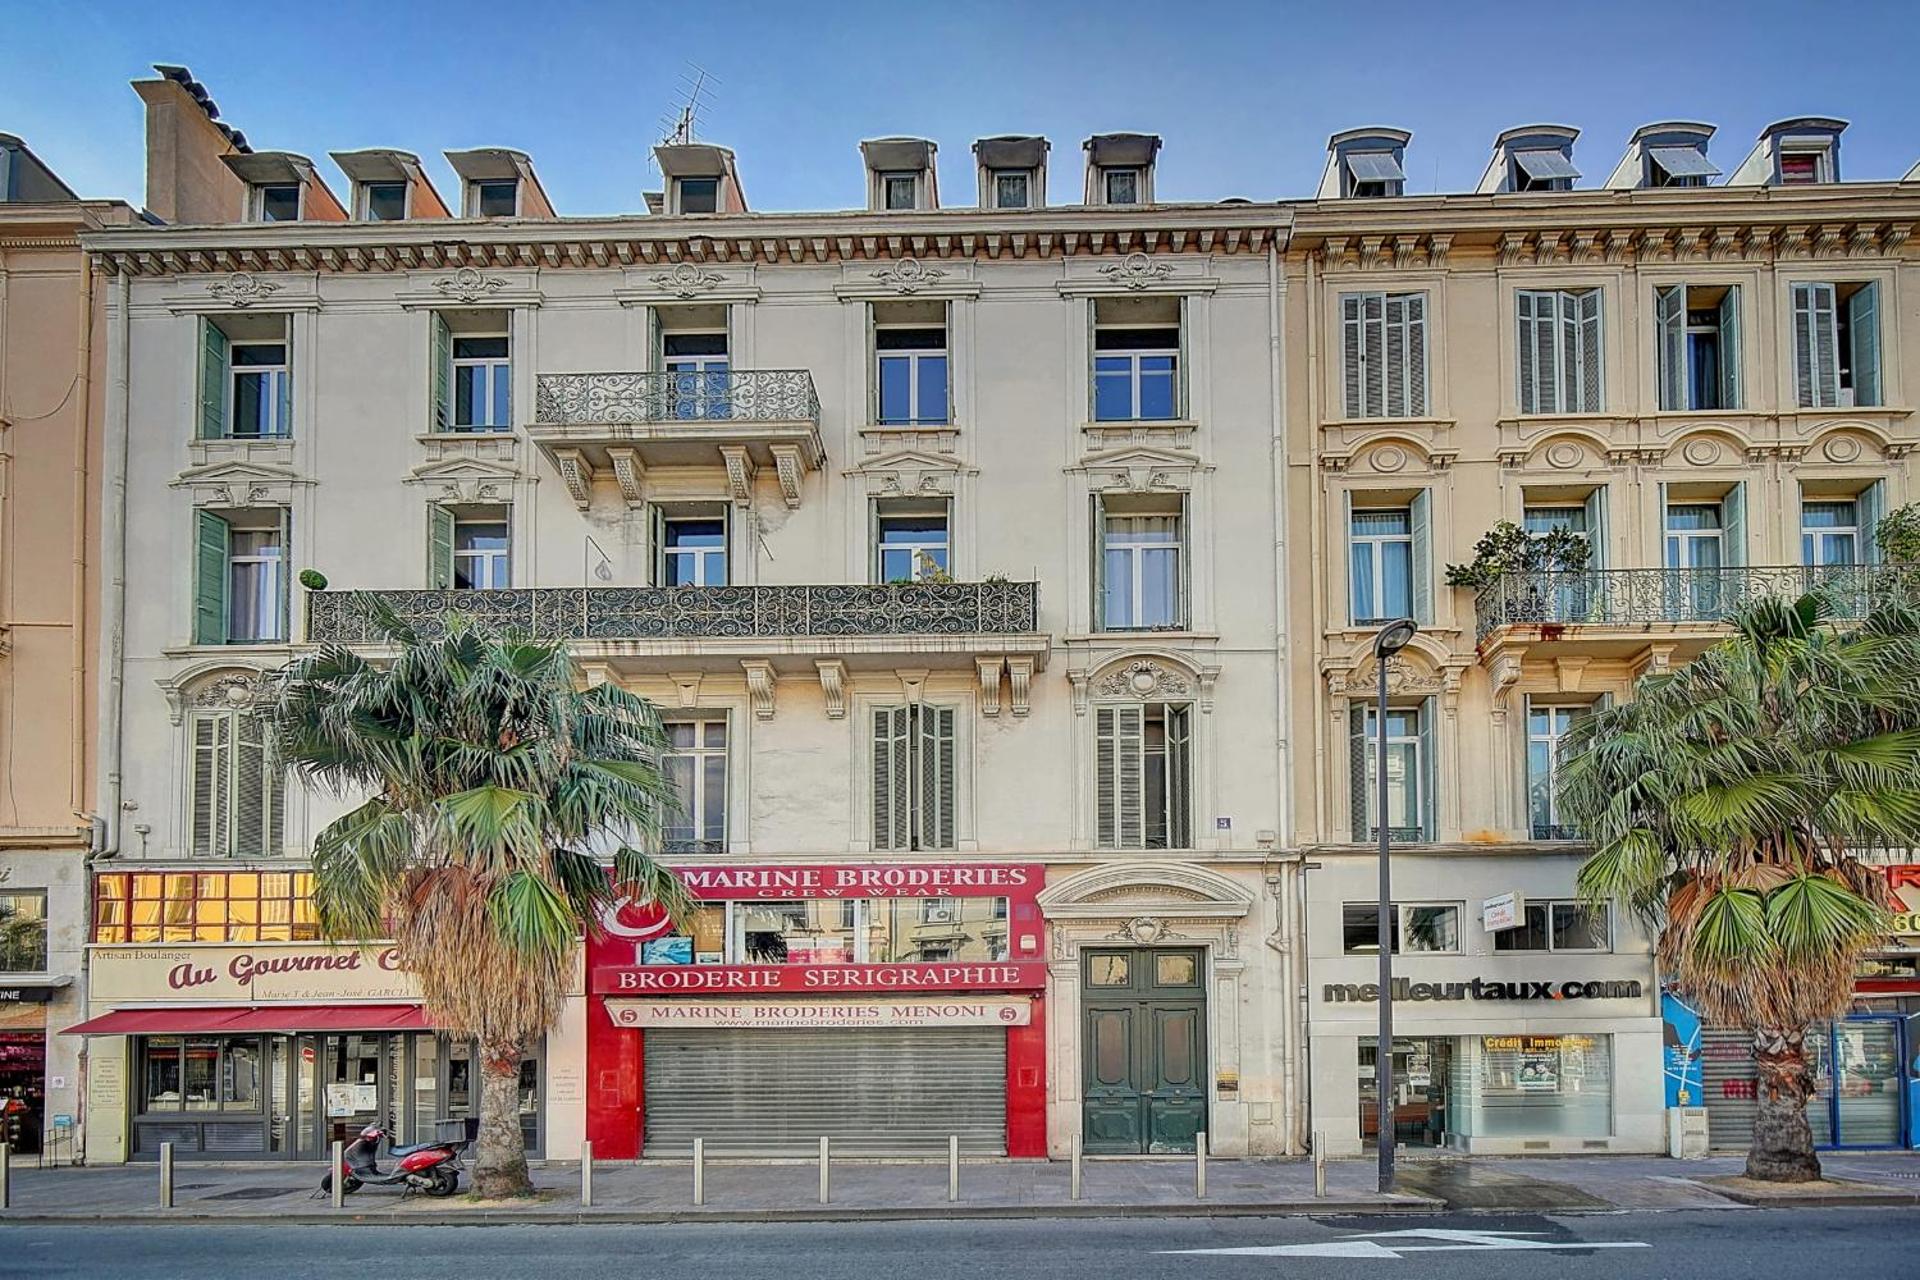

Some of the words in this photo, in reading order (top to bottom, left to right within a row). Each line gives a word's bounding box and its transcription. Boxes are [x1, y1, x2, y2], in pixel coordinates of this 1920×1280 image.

[682, 870, 821, 888] MARINE
[836, 868, 1027, 886] BRODERIES
[757, 889, 844, 898] CREW
[866, 888, 952, 896] WEAR
[93, 950, 132, 960] Artisan
[134, 950, 192, 962] Boulanger
[168, 962, 218, 989] Au
[228, 950, 361, 985] Gourmet
[618, 970, 782, 989] BRODERIE
[804, 967, 1020, 987] SERIGRAPHIE
[367, 988, 410, 997] GARCIA
[1322, 977, 1642, 1002] melleurtaux.com
[652, 1007, 742, 1018] MARINE
[754, 1006, 880, 1018] BRODERIES
[891, 1005, 985, 1017] MENONI
